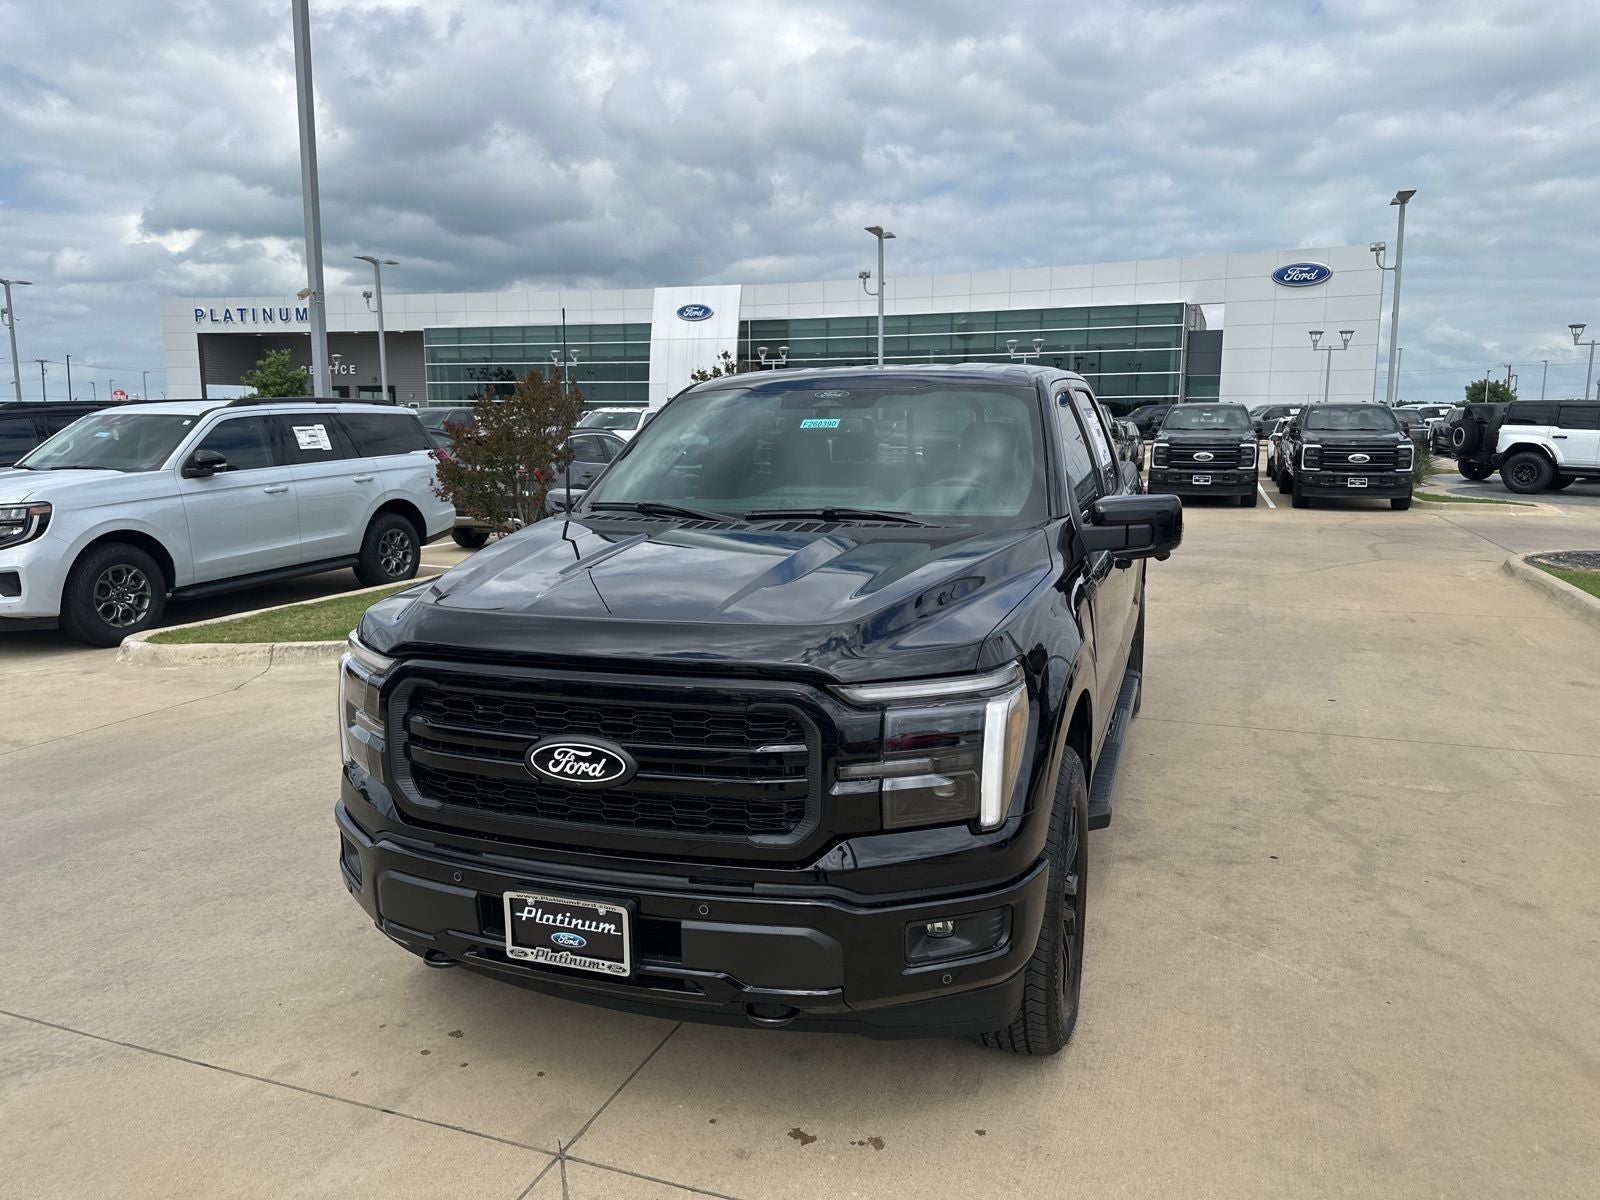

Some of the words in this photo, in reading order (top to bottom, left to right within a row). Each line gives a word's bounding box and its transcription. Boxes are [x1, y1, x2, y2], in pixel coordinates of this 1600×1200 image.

[1283, 266, 1318, 281] Ford
[194, 306, 309, 323] PLATINUM
[683, 306, 704, 317] Ford
[300, 364, 356, 375] SEICE
[548, 747, 607, 777] Ford
[515, 906, 622, 935] Platinum
[557, 934, 580, 947] Ford
[535, 948, 601, 971] Platinum
